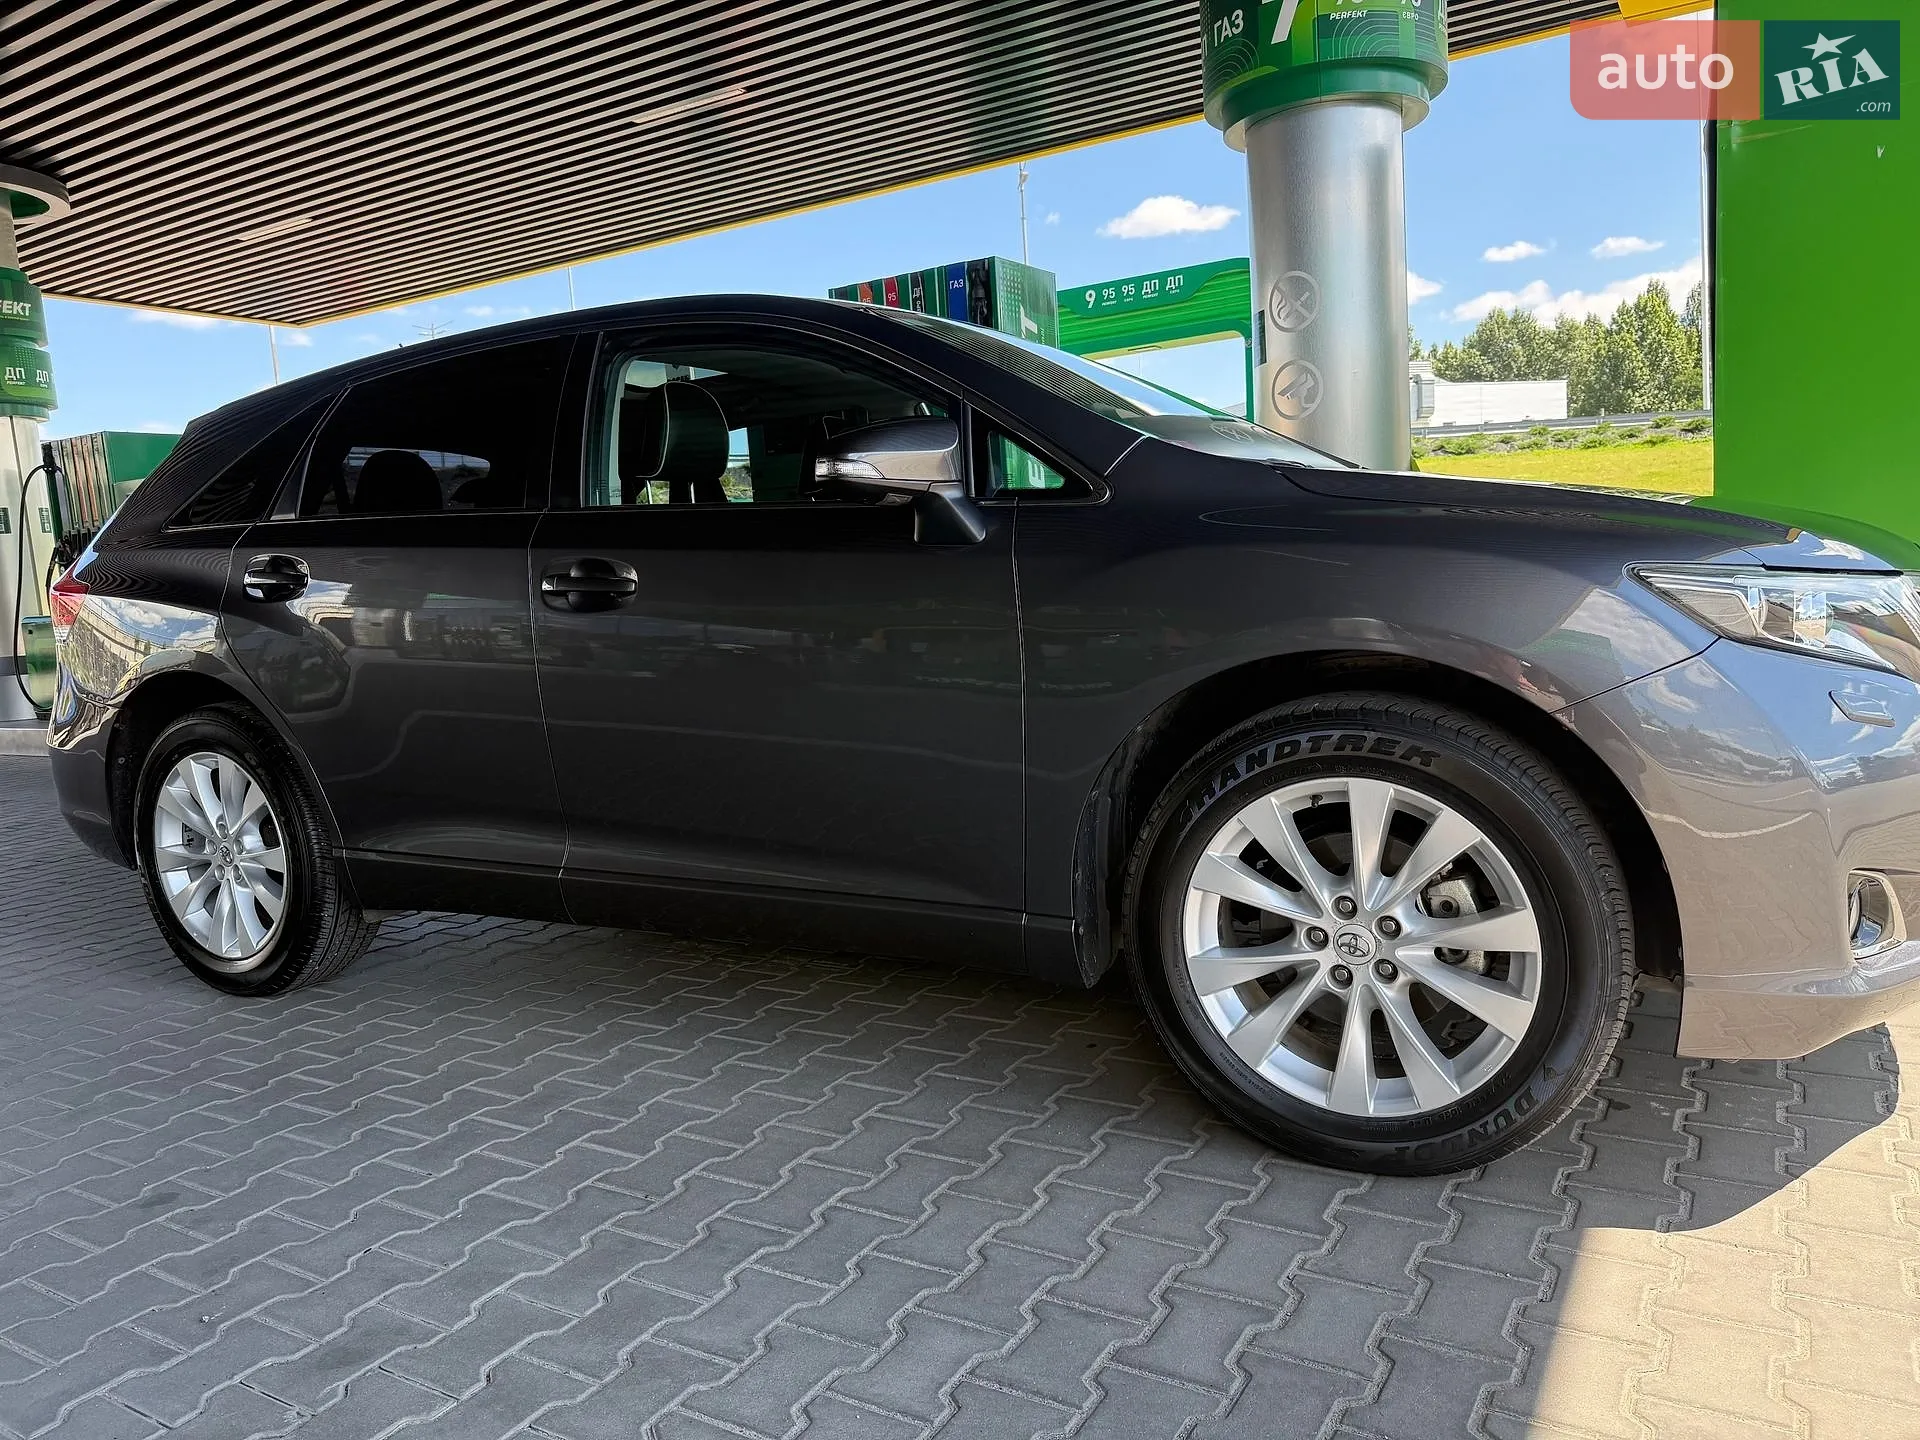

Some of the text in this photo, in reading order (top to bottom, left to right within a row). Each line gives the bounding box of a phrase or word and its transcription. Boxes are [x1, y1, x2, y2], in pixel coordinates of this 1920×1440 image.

[1329, 10, 1368, 20] PERFEKT
[1213, 9, 1244, 47] ГАЗ
[949, 279, 964, 290] ГАЗ
[1102, 287, 1116, 300] 95
[1121, 284, 1135, 296] 95
[1142, 279, 1159, 295] ДП
[1165, 275, 1184, 291] ДП
[887, 292, 897, 302] 95
[0, 300, 32, 316] EKT
[5, 366, 49, 383] ДП ДП
